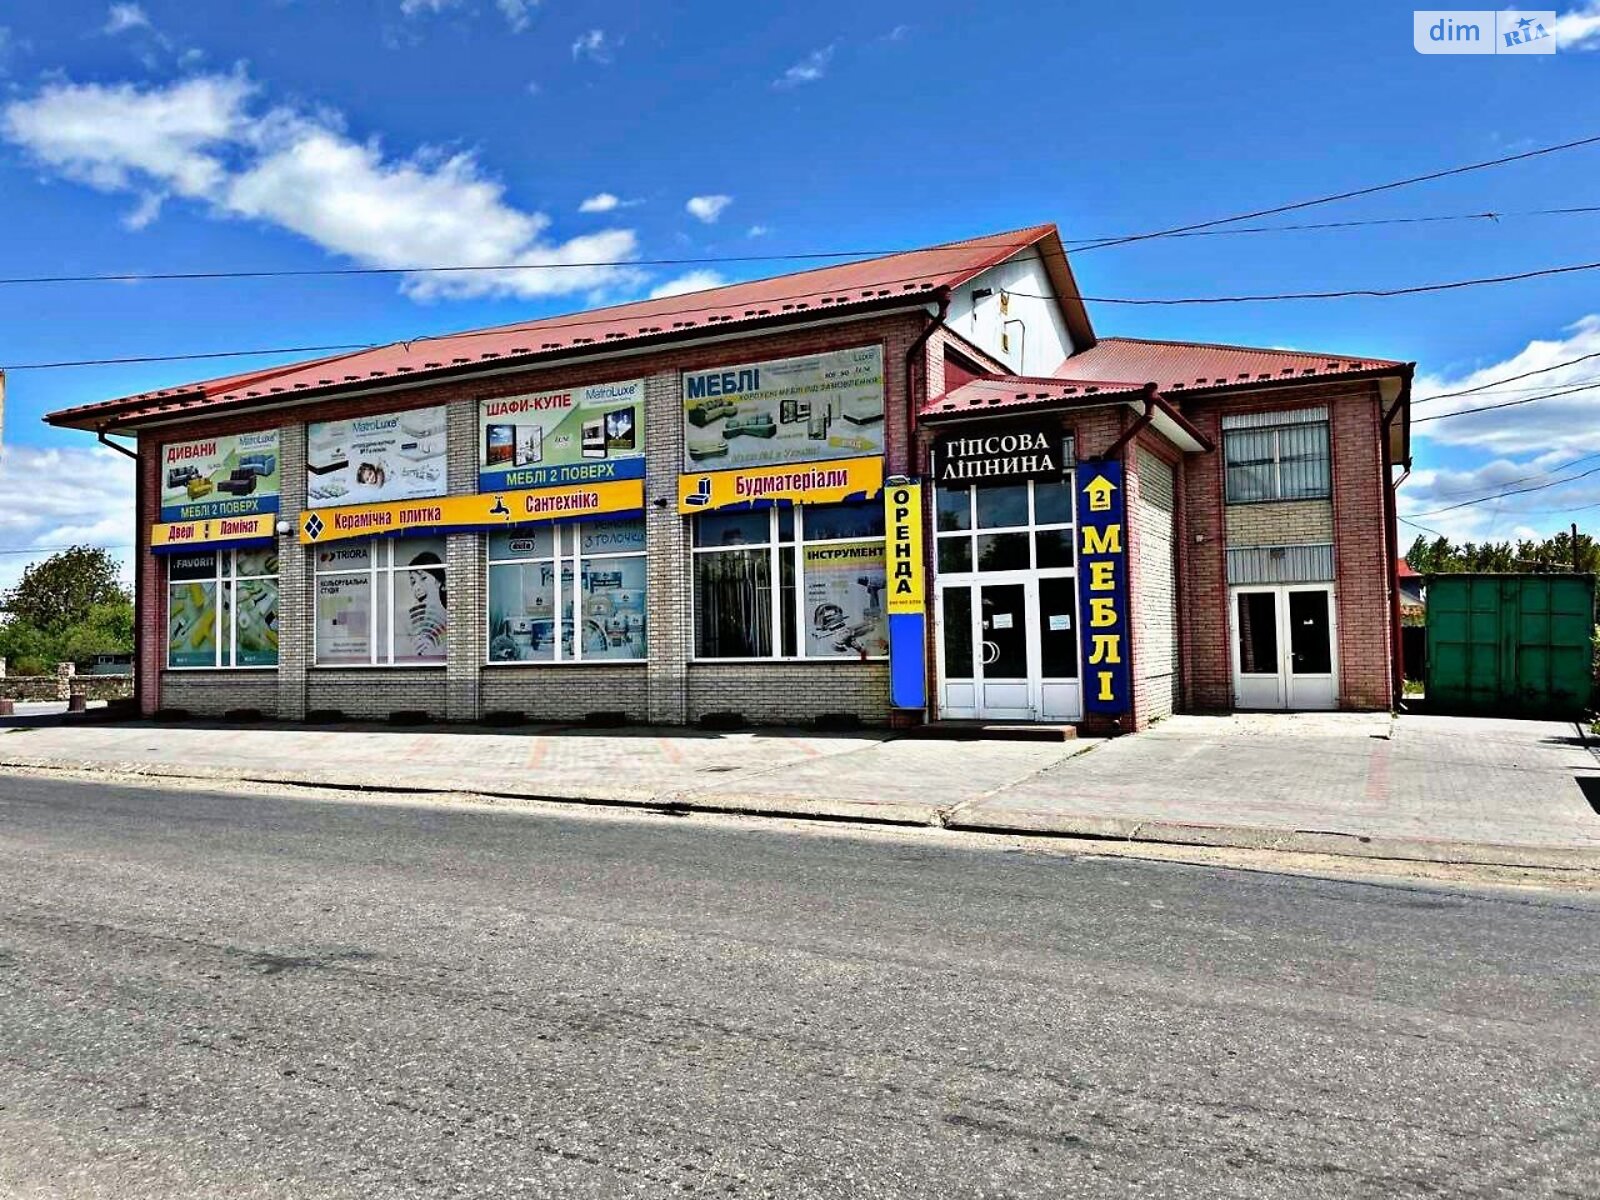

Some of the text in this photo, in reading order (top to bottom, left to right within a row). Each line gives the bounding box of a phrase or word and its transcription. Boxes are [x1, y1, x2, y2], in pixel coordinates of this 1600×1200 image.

[687, 368, 760, 399] МЕБЛІ
[486, 393, 572, 417] ШАФИ-КУПЕ
[167, 442, 216, 464] ДИВАНИ
[946, 432, 1050, 458] ГІПСОВА
[506, 463, 615, 486] МЕБЛІ 2 ПОВЕРХ
[942, 454, 1056, 480] ЛІПНИНА
[735, 468, 848, 497] Будматеріали
[526, 490, 598, 513] Сантехніка
[1096, 490, 1105, 502] 2
[181, 500, 259, 518] МЕБЛІ 2 ПОВЕРХ
[334, 507, 441, 530] Керамічна плитка
[168, 519, 259, 542] Двері Ламінат
[893, 489, 912, 594] ОРЕНДА
[177, 556, 215, 568] FAVORIT
[335, 549, 368, 560] TRIORA
[807, 546, 885, 560] ІНСТРУМЕНТ
[1082, 524, 1122, 701] МЕБЛІ
